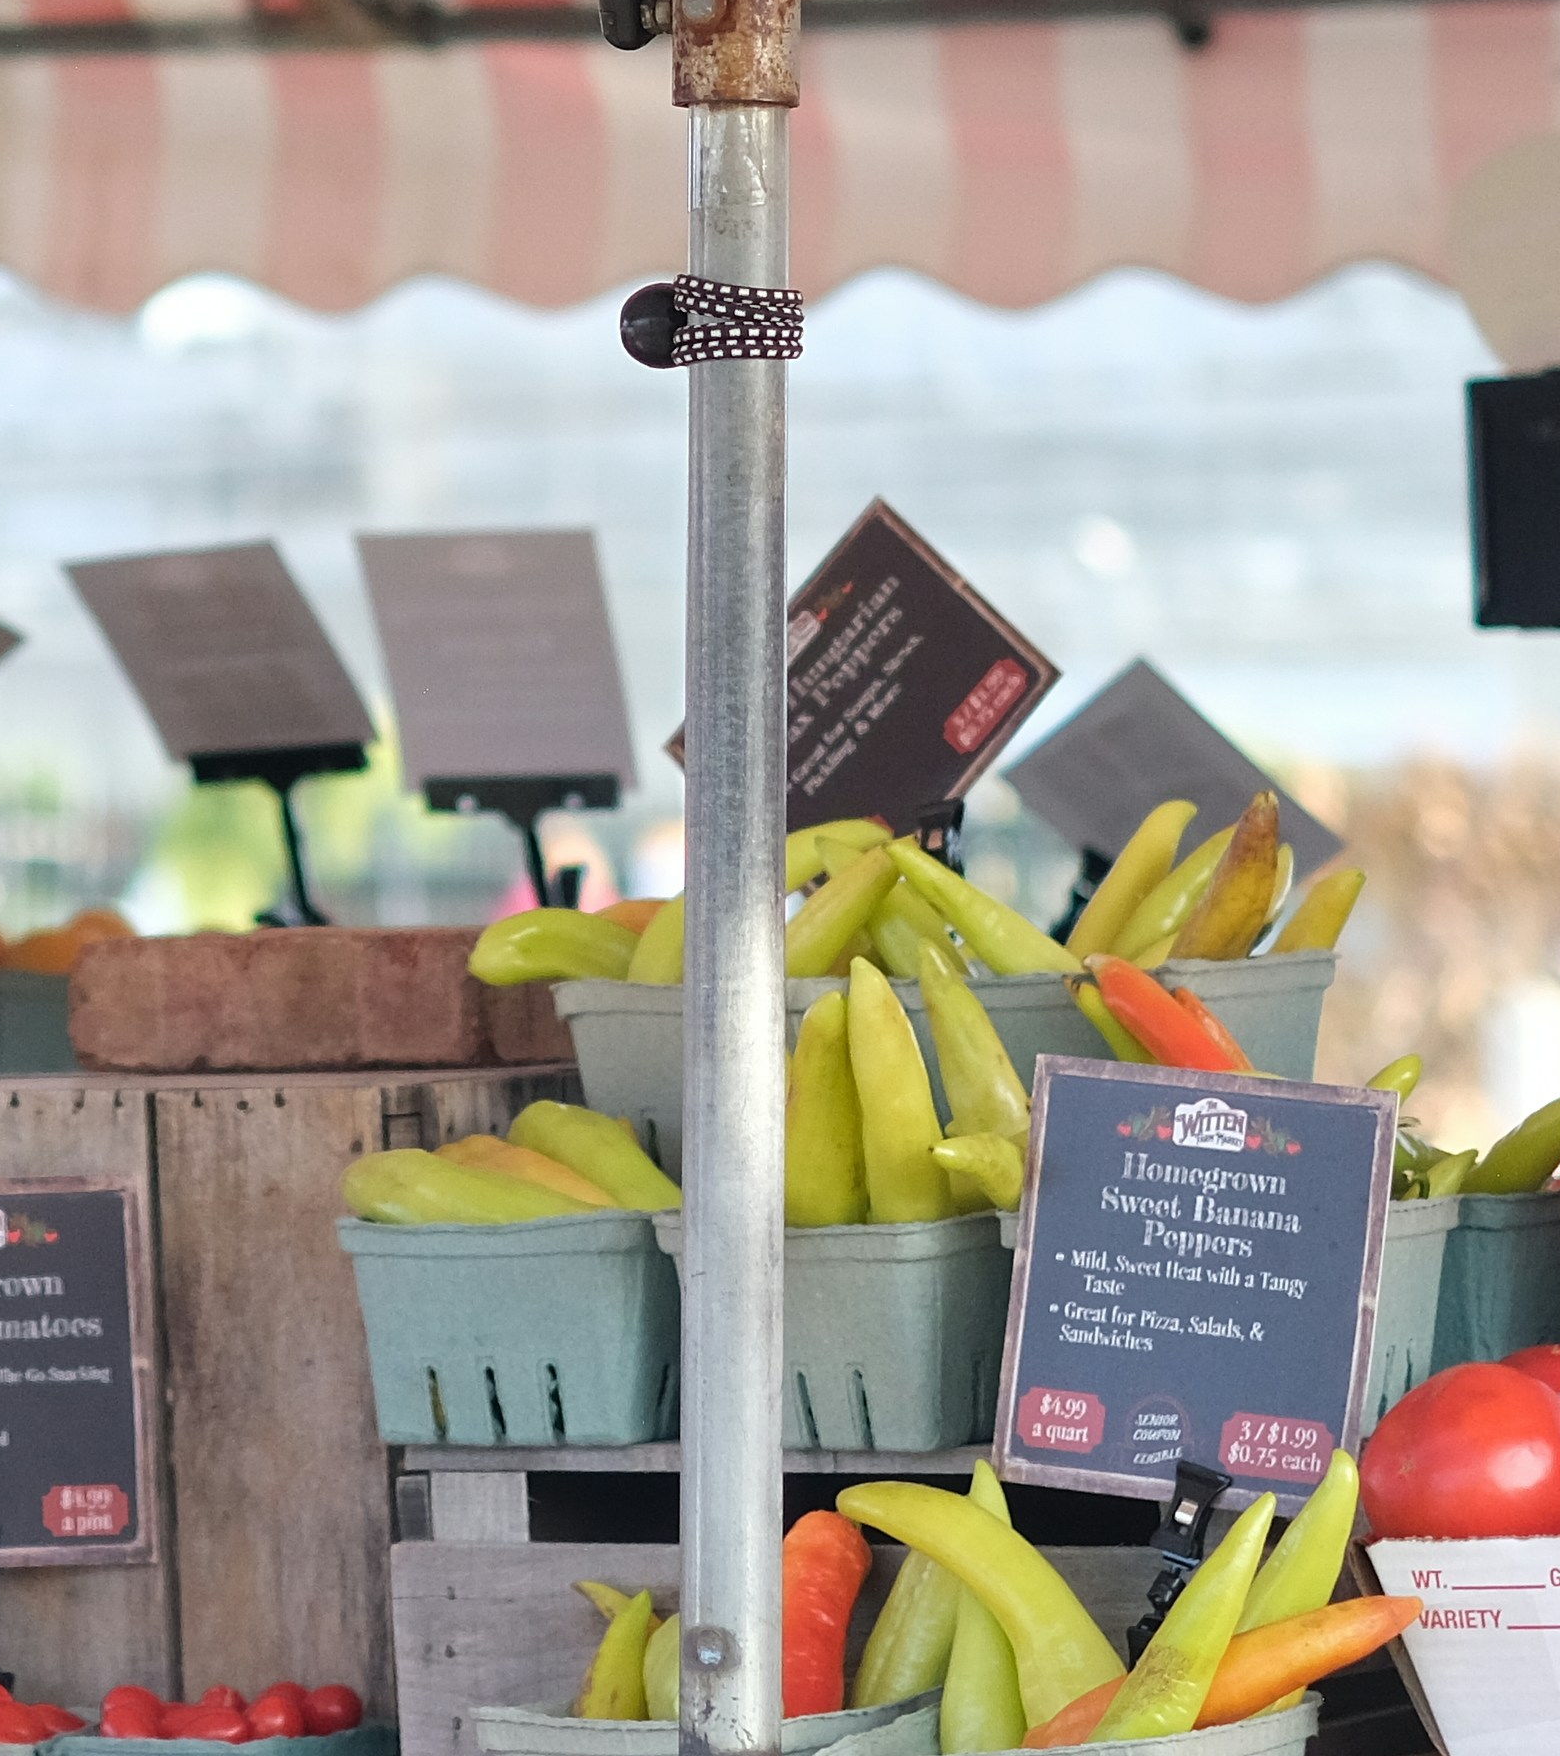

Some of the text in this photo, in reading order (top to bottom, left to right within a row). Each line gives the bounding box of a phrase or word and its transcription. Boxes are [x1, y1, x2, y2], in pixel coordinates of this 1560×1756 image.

[809, 607, 904, 709] Peppers
[1175, 1111, 1246, 1144] WITTEN
[1121, 1151, 1287, 1196] Homegrown
[1100, 1185, 1302, 1235] Sweet Banana
[1142, 1218, 1253, 1260] Peppers
[1070, 1249, 1308, 1300] Mild, Sweet Heat with a Tangy
[1083, 1274, 1125, 1297] Taste
[1058, 1323, 1154, 1352] Sandwiches
[1064, 1301, 1266, 1342] Great for Pizza, Salads, &
[1032, 1423, 1090, 1445] a quart
[1132, 1429, 1181, 1441] COUPON
[1239, 1420, 1318, 1448] 3 / $1.99
[1226, 1442, 1322, 1474] $0.75 each
[1411, 1568, 1450, 1591] WT.
[1419, 1608, 1503, 1632] VARIETY
